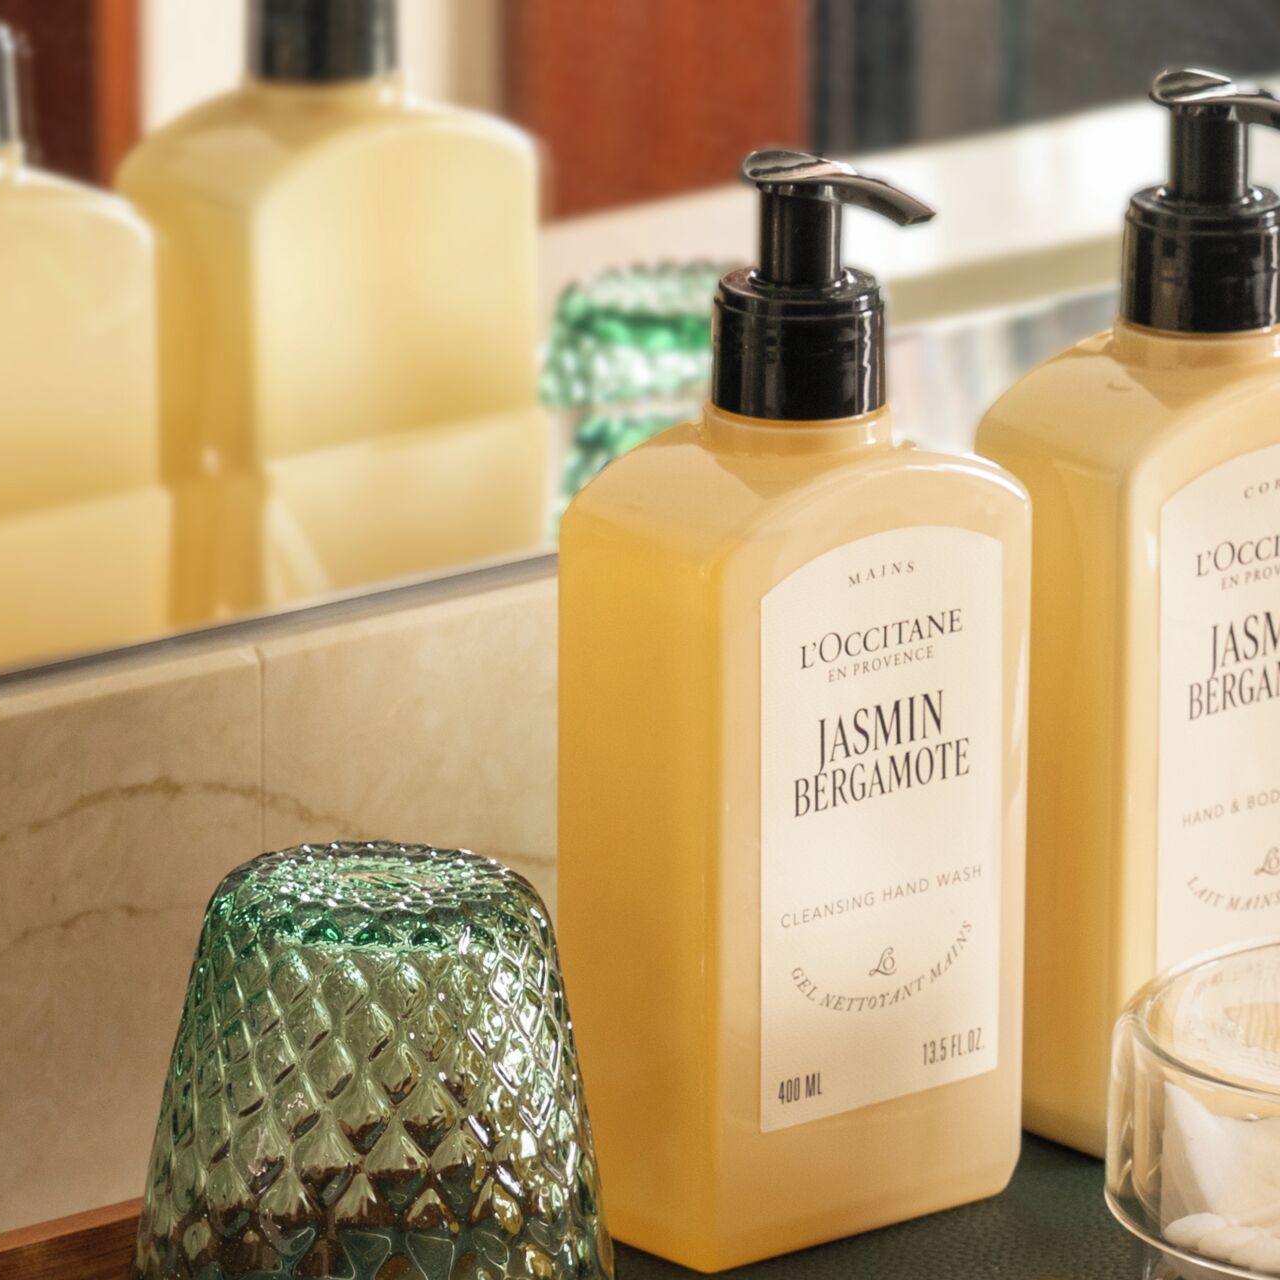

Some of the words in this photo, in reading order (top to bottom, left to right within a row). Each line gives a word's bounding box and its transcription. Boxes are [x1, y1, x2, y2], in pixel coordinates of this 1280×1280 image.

[848, 561, 916, 588] MAINS
[1221, 576, 1239, 590] EN
[828, 666, 847, 683] EN
[853, 645, 934, 676] PROVENCE
[818, 689, 945, 773] JASMIN
[794, 737, 970, 818] BERGAMOTE
[1182, 804, 1225, 827] HAND
[1231, 800, 1241, 814] &
[780, 892, 875, 929] CLEANSING
[883, 878, 930, 901] HAND
[936, 864, 982, 888] WASH
[1187, 876, 1225, 908] LAIT
[791, 967, 817, 1002] GEL
[820, 976, 926, 1012] NETTOYANT
[929, 920, 973, 983] MAINS
[923, 1036, 947, 1066] 13.5
[778, 1076, 801, 1105] 400
[805, 1072, 823, 1097] ML
